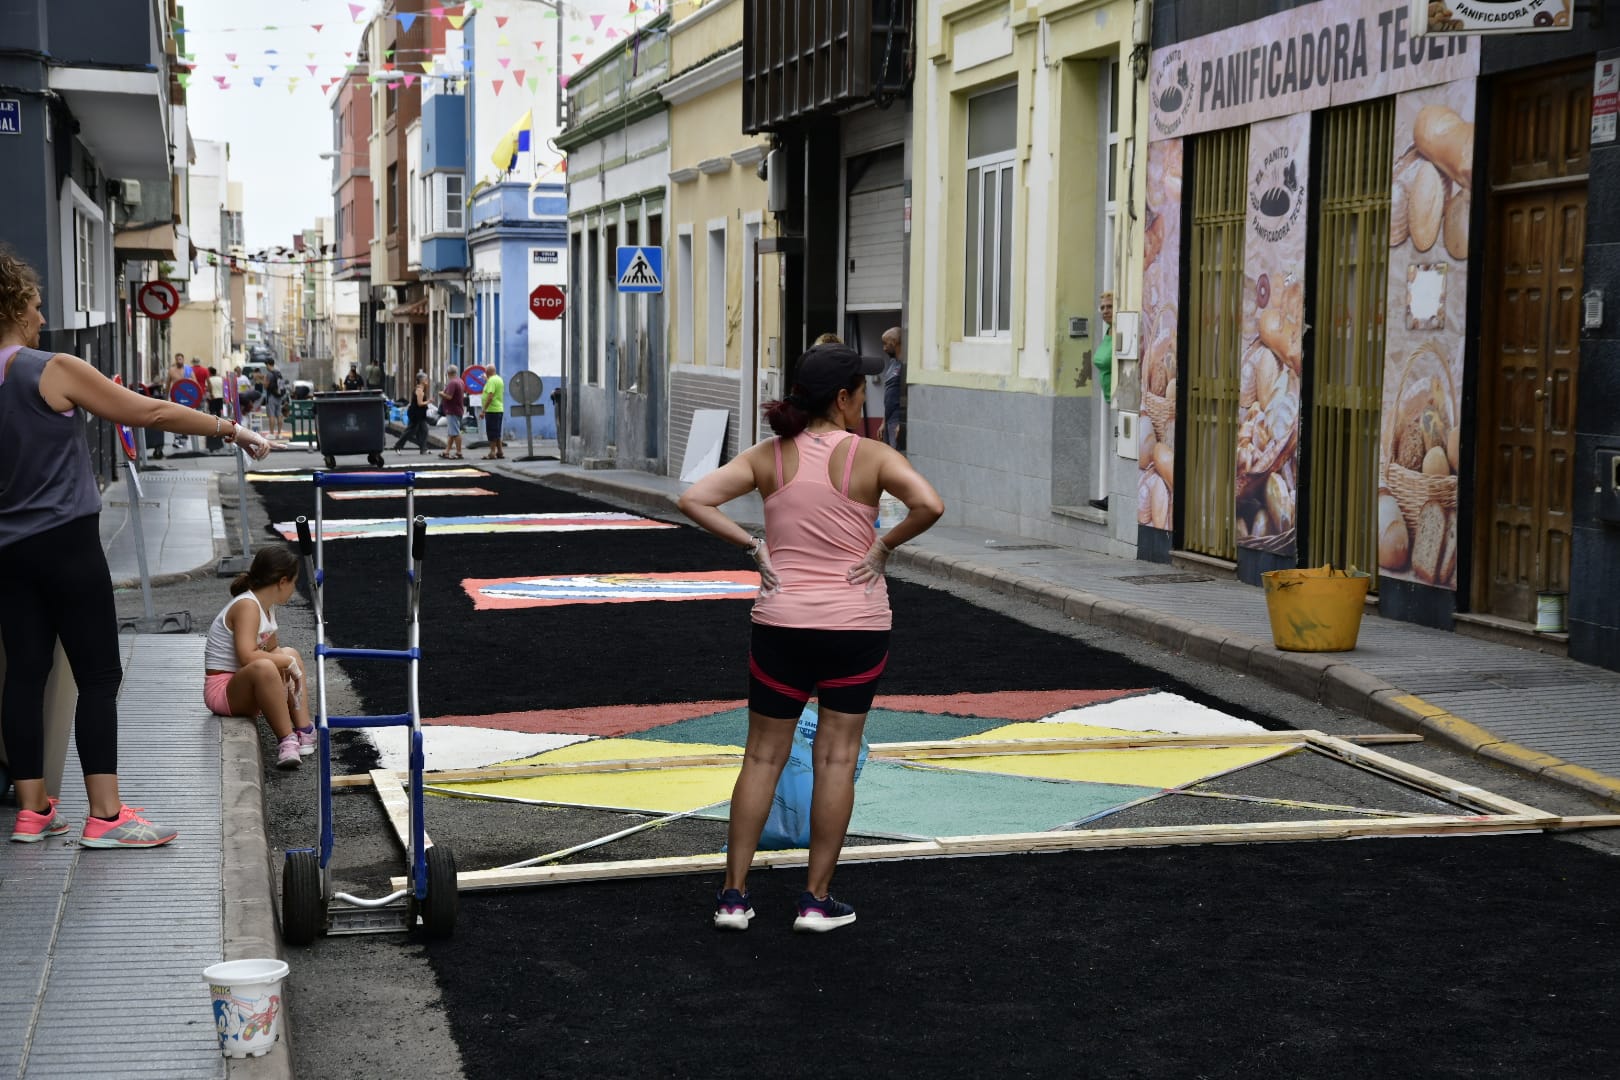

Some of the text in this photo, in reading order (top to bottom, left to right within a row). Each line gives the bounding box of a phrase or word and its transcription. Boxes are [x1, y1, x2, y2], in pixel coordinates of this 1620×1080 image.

[1456, 2, 1529, 23] PANIFICADORA
[1199, 18, 1368, 113] PANIFICADORA
[0, 102, 14, 111] LE
[0, 117, 16, 131] AL
[1264, 146, 1289, 170] PANITO
[1252, 215, 1290, 243] PANIFICADORA
[533, 298, 562, 307] STOP
